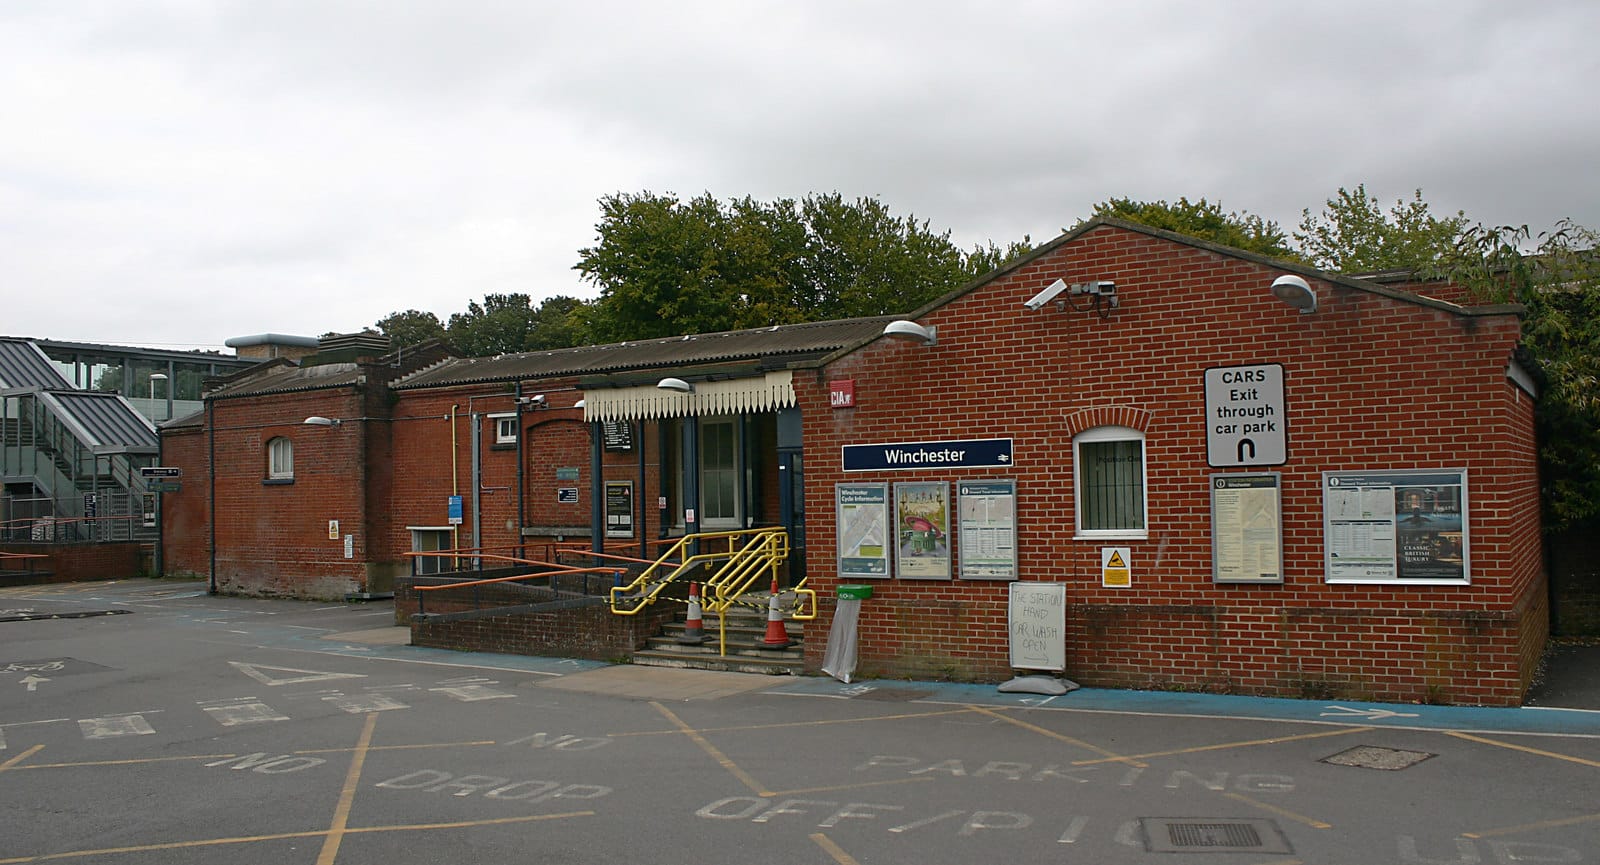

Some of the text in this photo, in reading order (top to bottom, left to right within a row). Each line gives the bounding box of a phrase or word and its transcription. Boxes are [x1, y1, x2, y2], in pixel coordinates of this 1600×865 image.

[1222, 370, 1266, 384] CARS
[1230, 388, 1259, 401] Exit
[1217, 404, 1274, 418] through
[1215, 420, 1276, 435] car park
[884, 448, 966, 464] Winchester
[1023, 607, 1049, 619] HAND
[1012, 621, 1058, 640] CAR WASH
[1022, 638, 1048, 652] OPEN
[505, 732, 1297, 793] NO PARKING
[204, 751, 328, 774] NO
[374, 768, 613, 801] DROP
